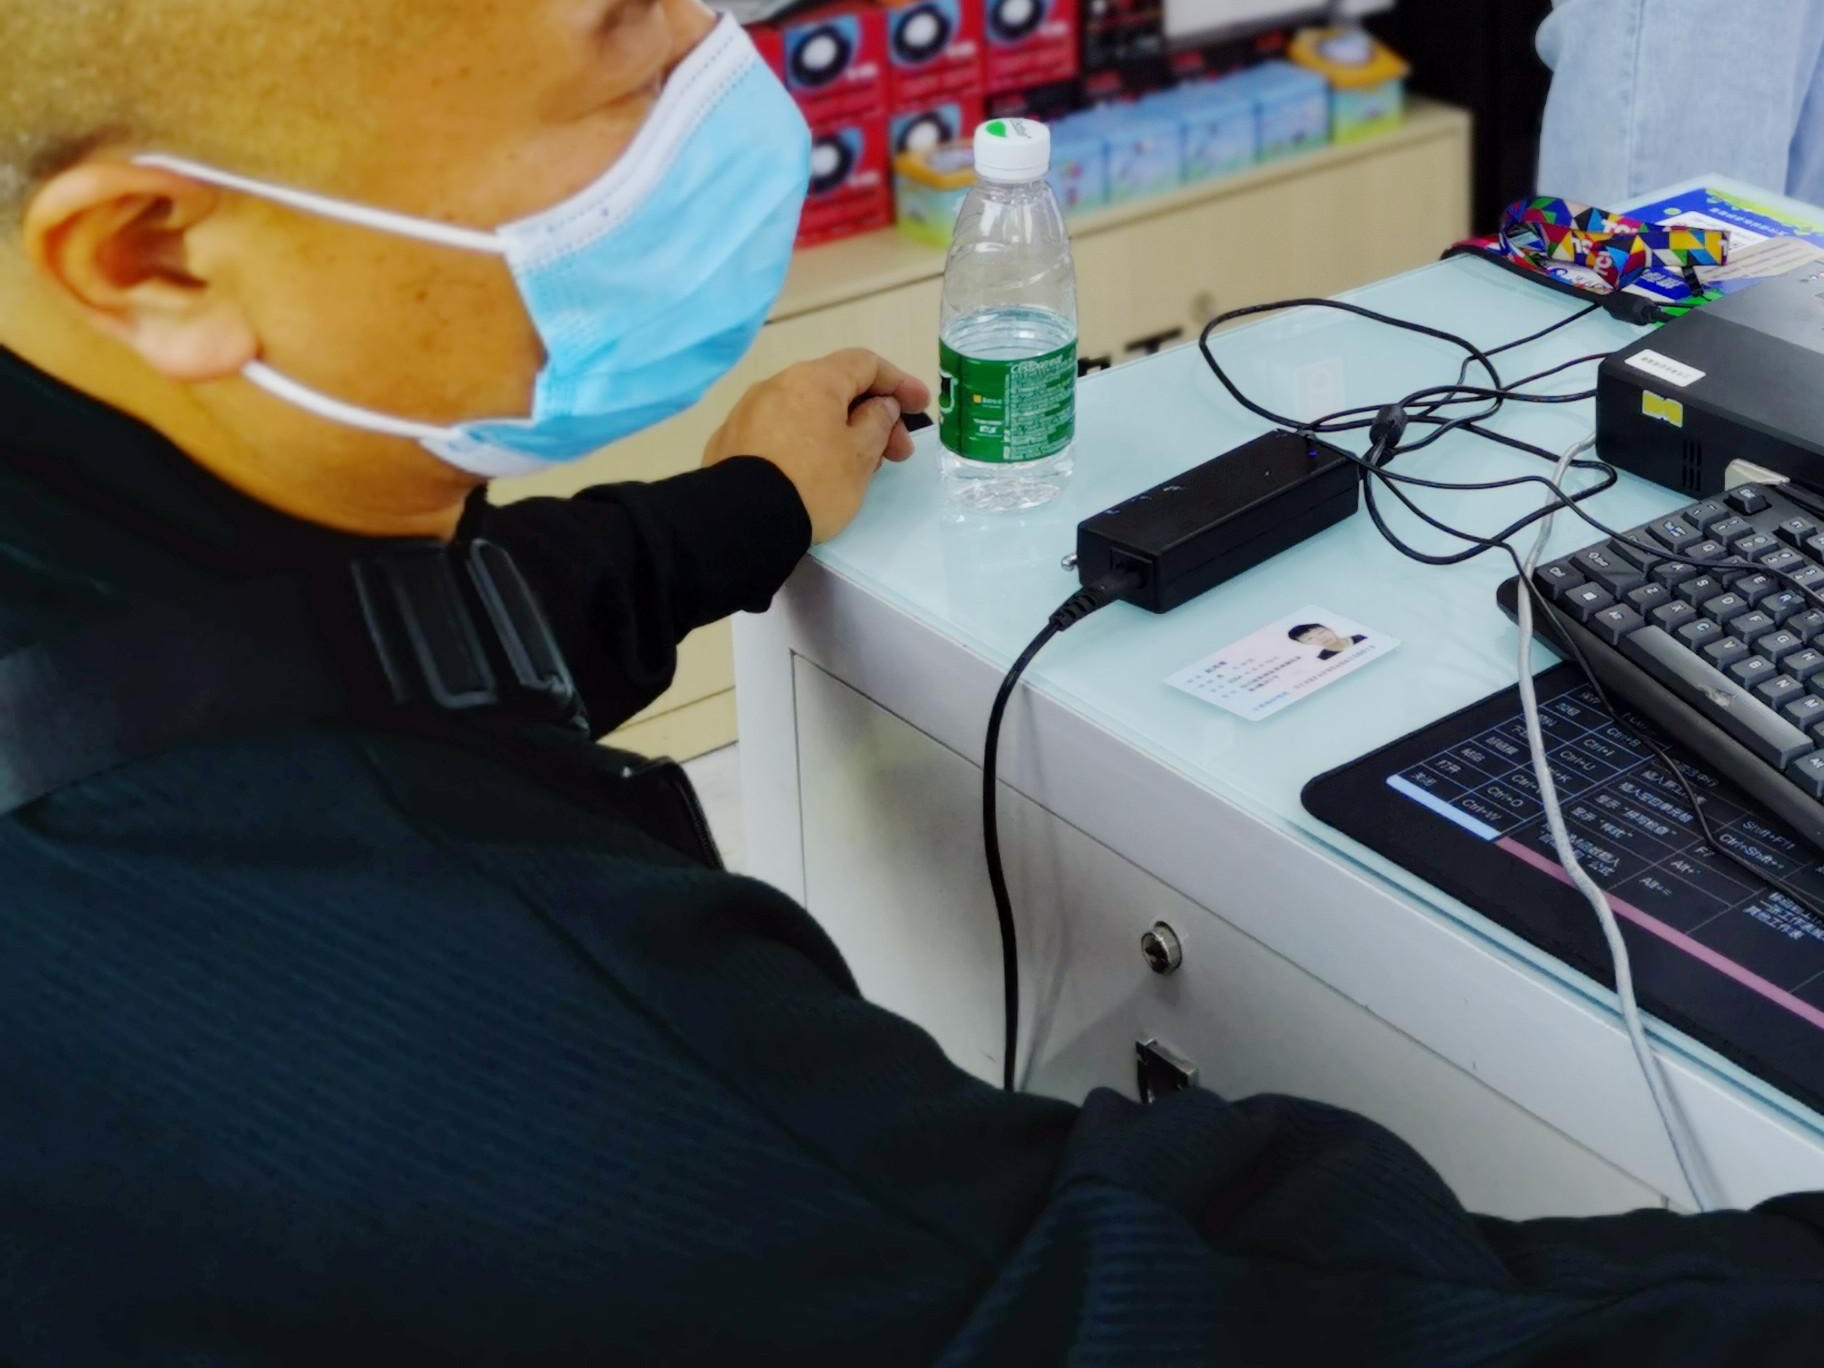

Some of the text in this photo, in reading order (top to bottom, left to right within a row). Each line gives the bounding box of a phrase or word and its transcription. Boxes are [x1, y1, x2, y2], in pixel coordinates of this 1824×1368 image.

[1583, 737, 1615, 757] Ctrl+I
[1605, 725, 1642, 749] Ctrl+B
[1559, 749, 1597, 772] Ctrl+U
[1487, 785, 1525, 808] Ctrl+O
[1461, 798, 1502, 822] Ctrl+W
[1742, 820, 1796, 851] Shift+F11
